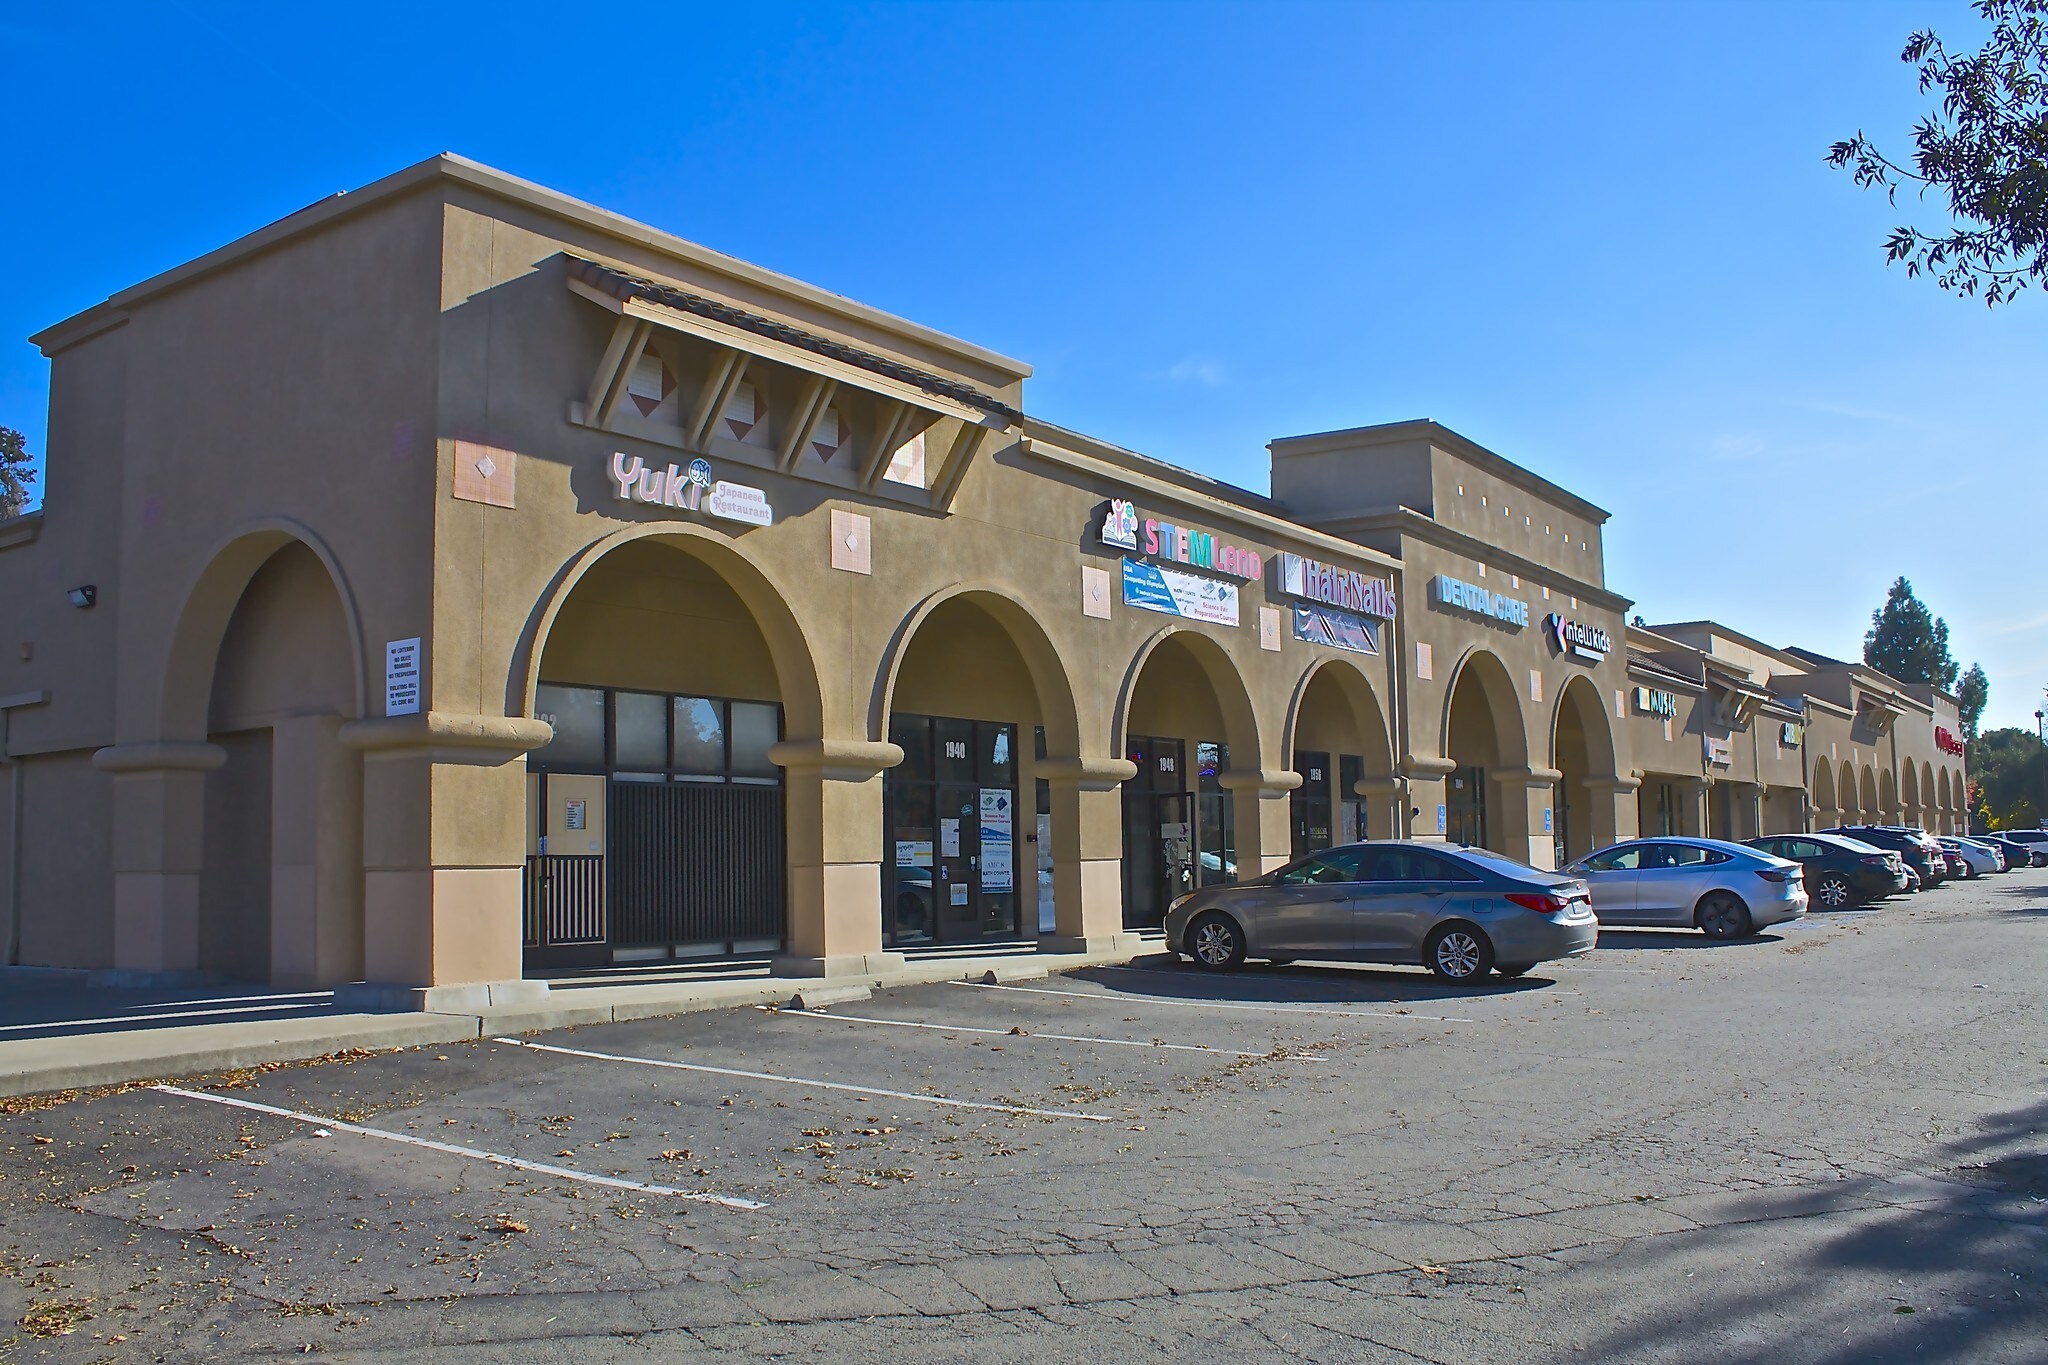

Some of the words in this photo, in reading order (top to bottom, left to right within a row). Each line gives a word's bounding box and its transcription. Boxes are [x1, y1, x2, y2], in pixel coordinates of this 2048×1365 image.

[613, 452, 703, 511] Yuki
[719, 484, 763, 502] Japanese
[713, 497, 769, 519] Restaurant
[1202, 601, 1219, 610] Science
[1441, 574, 1494, 616] DENTAL
[1494, 593, 1529, 628] CARE
[1650, 689, 1677, 717] MUSIC
[945, 741, 966, 759] 1940
